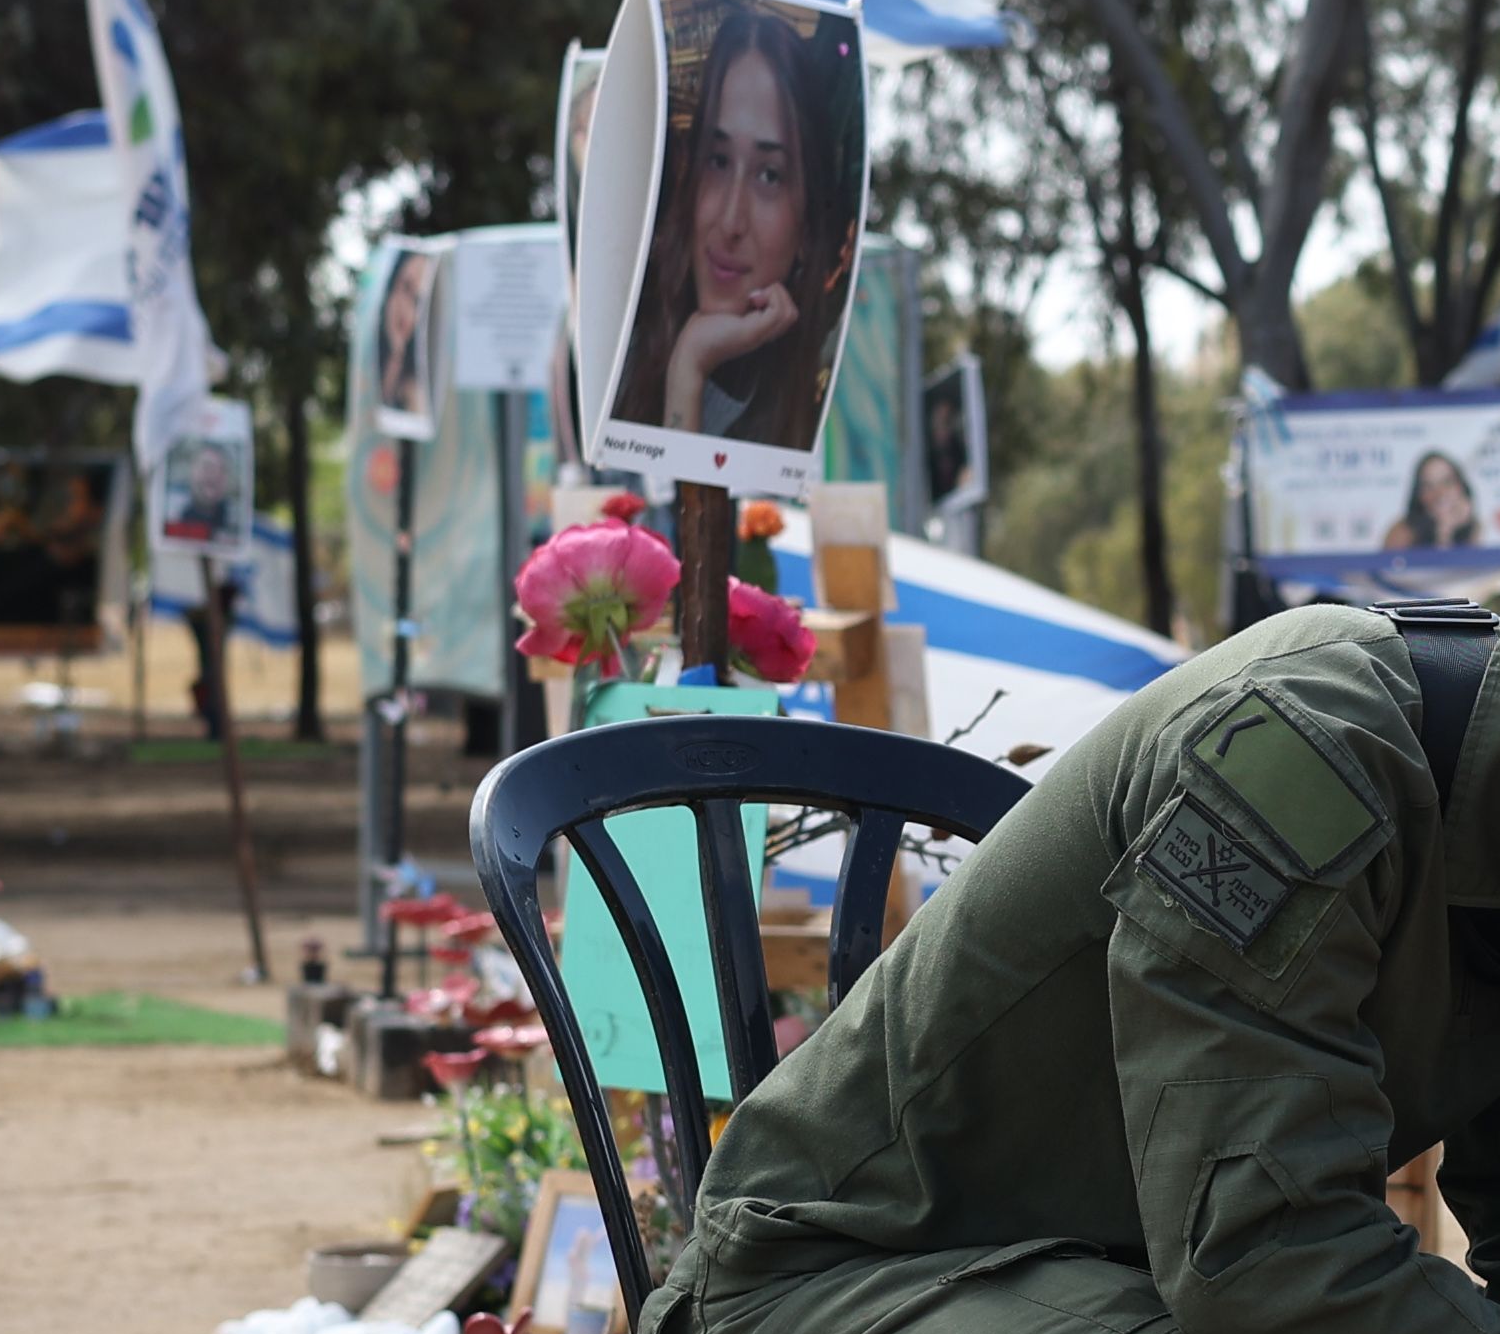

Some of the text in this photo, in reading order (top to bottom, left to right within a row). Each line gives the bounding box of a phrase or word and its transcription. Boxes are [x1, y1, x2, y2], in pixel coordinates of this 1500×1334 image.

[603, 436, 627, 451] Noa
[1175, 826, 1202, 857] ביחד
[1225, 889, 1256, 921] ברזל
[1228, 877, 1269, 912] חרבות
